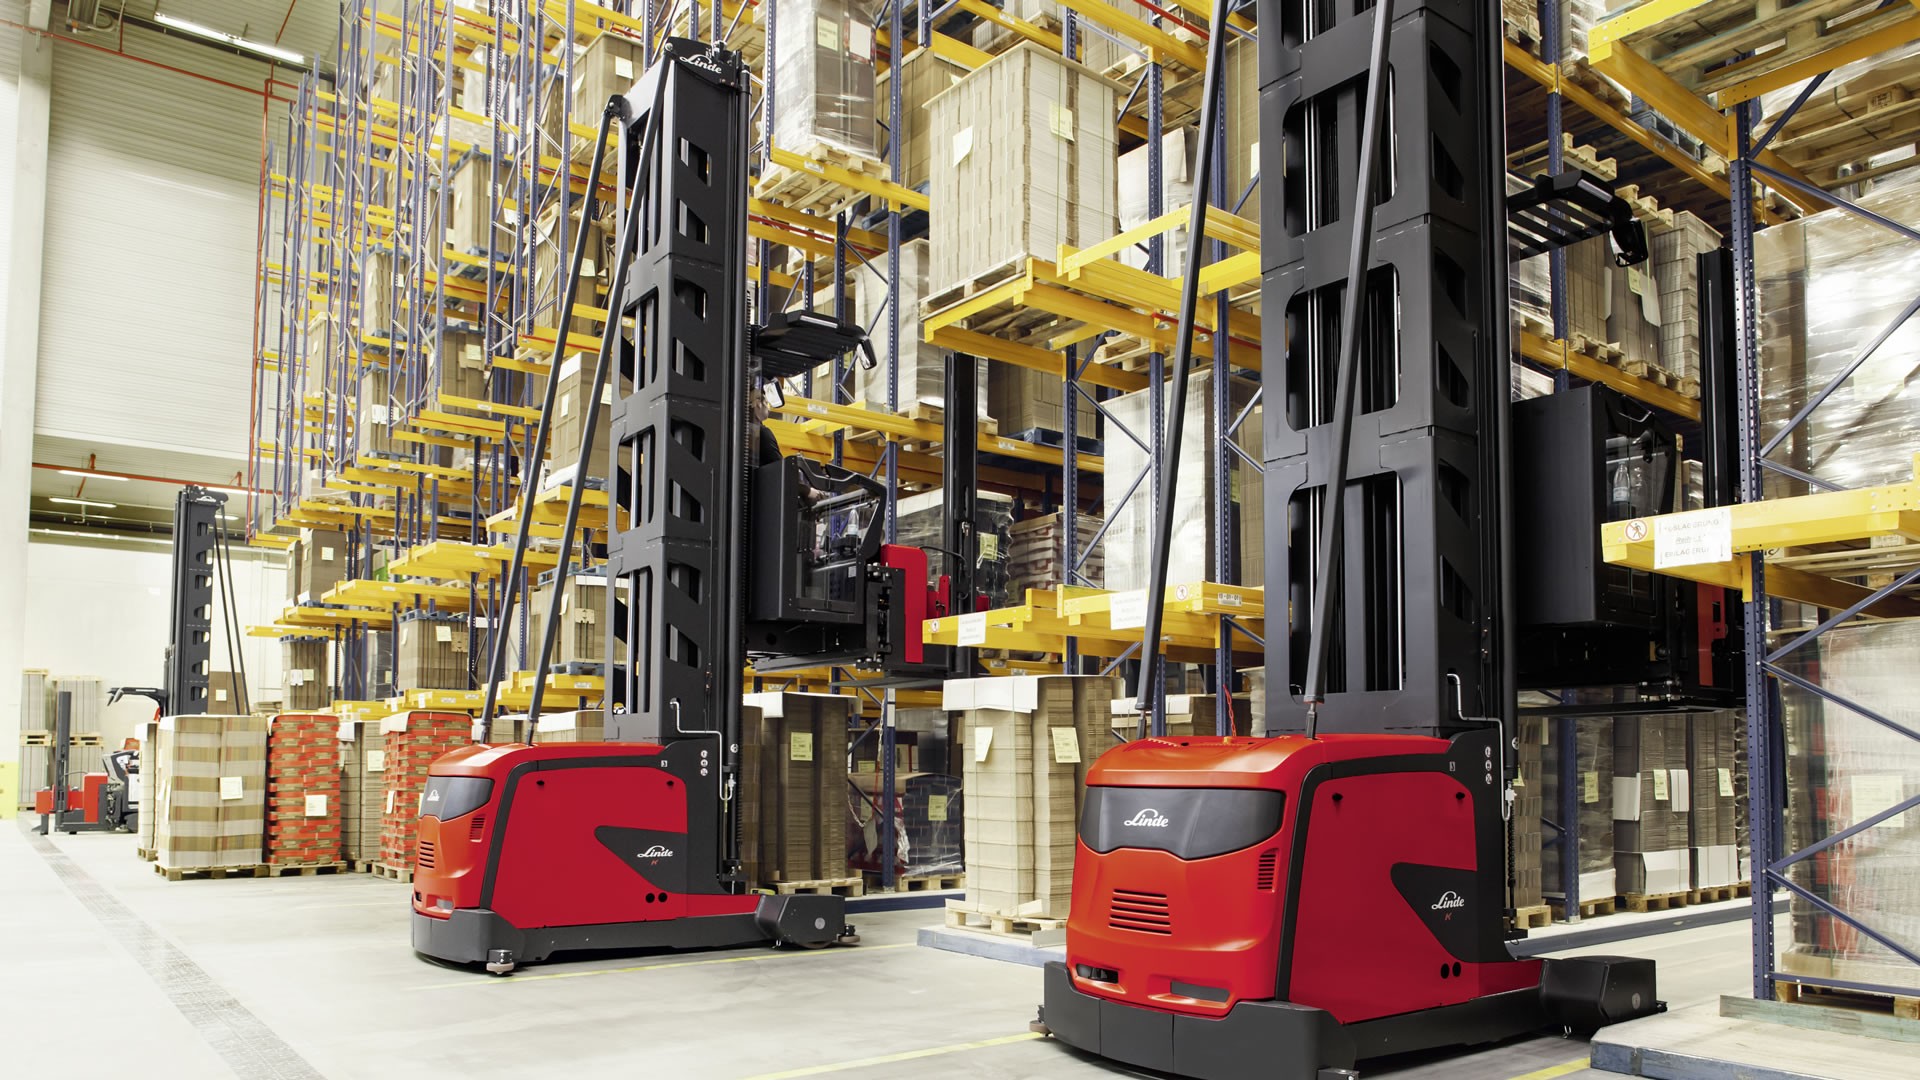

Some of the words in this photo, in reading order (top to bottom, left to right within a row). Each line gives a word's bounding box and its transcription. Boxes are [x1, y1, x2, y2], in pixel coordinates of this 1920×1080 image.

[679, 54, 722, 74] Linde
[1123, 808, 1169, 828] Linde
[636, 844, 674, 858] Linde
[1431, 890, 1465, 910] Linde
